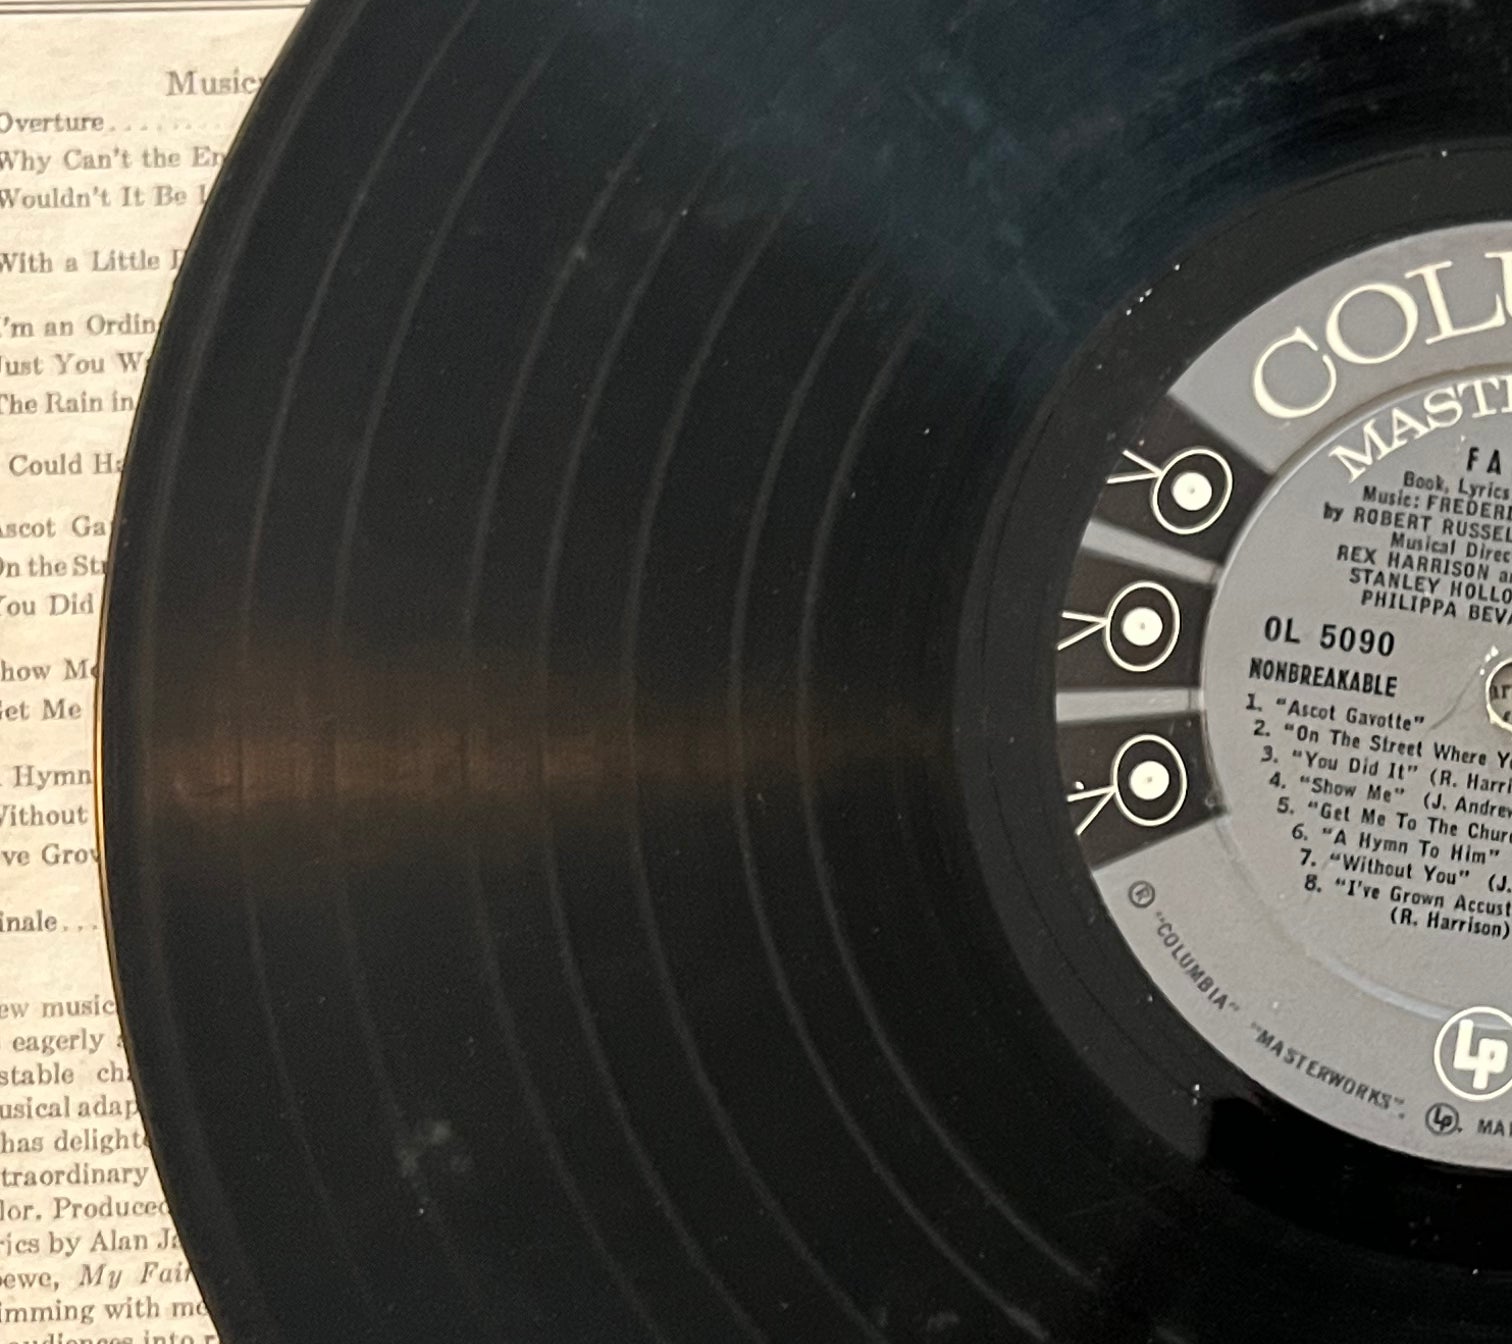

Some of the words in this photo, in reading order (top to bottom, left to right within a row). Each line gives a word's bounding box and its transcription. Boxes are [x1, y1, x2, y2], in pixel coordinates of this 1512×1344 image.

[62, 146, 133, 171] Can't
[141, 146, 181, 169] the
[121, 185, 145, 207] It
[153, 184, 187, 207] Be
[45, 390, 103, 414] Rain
[111, 390, 135, 413] in
[1403, 471, 1449, 494] Book,
[1363, 485, 1420, 509] Music:
[1323, 502, 1344, 522] by
[1353, 507, 1433, 532] ROBERT
[1391, 531, 1456, 556] Musical
[1337, 544, 1377, 565] REX
[1387, 551, 1489, 581] HARRISON
[1349, 567, 1441, 594] STANLEY
[48, 592, 94, 616] Did
[1361, 589, 1457, 618] PHILIPPA
[1264, 616, 1300, 644] OL
[1320, 623, 1395, 657] 5090
[1249, 657, 1398, 698] NONBREAKABLE
[1245, 692, 1262, 712] 1.
[1253, 719, 1271, 737] 2.
[1329, 729, 1360, 749] The
[1369, 734, 1423, 758] Street
[1433, 741, 1487, 766] Where
[1304, 874, 1322, 893] 8.
[1390, 885, 1444, 908] Grown
[1390, 906, 1418, 926] (R.
[1426, 911, 1510, 940] Harrison)
[12, 1027, 105, 1057] eagerly
